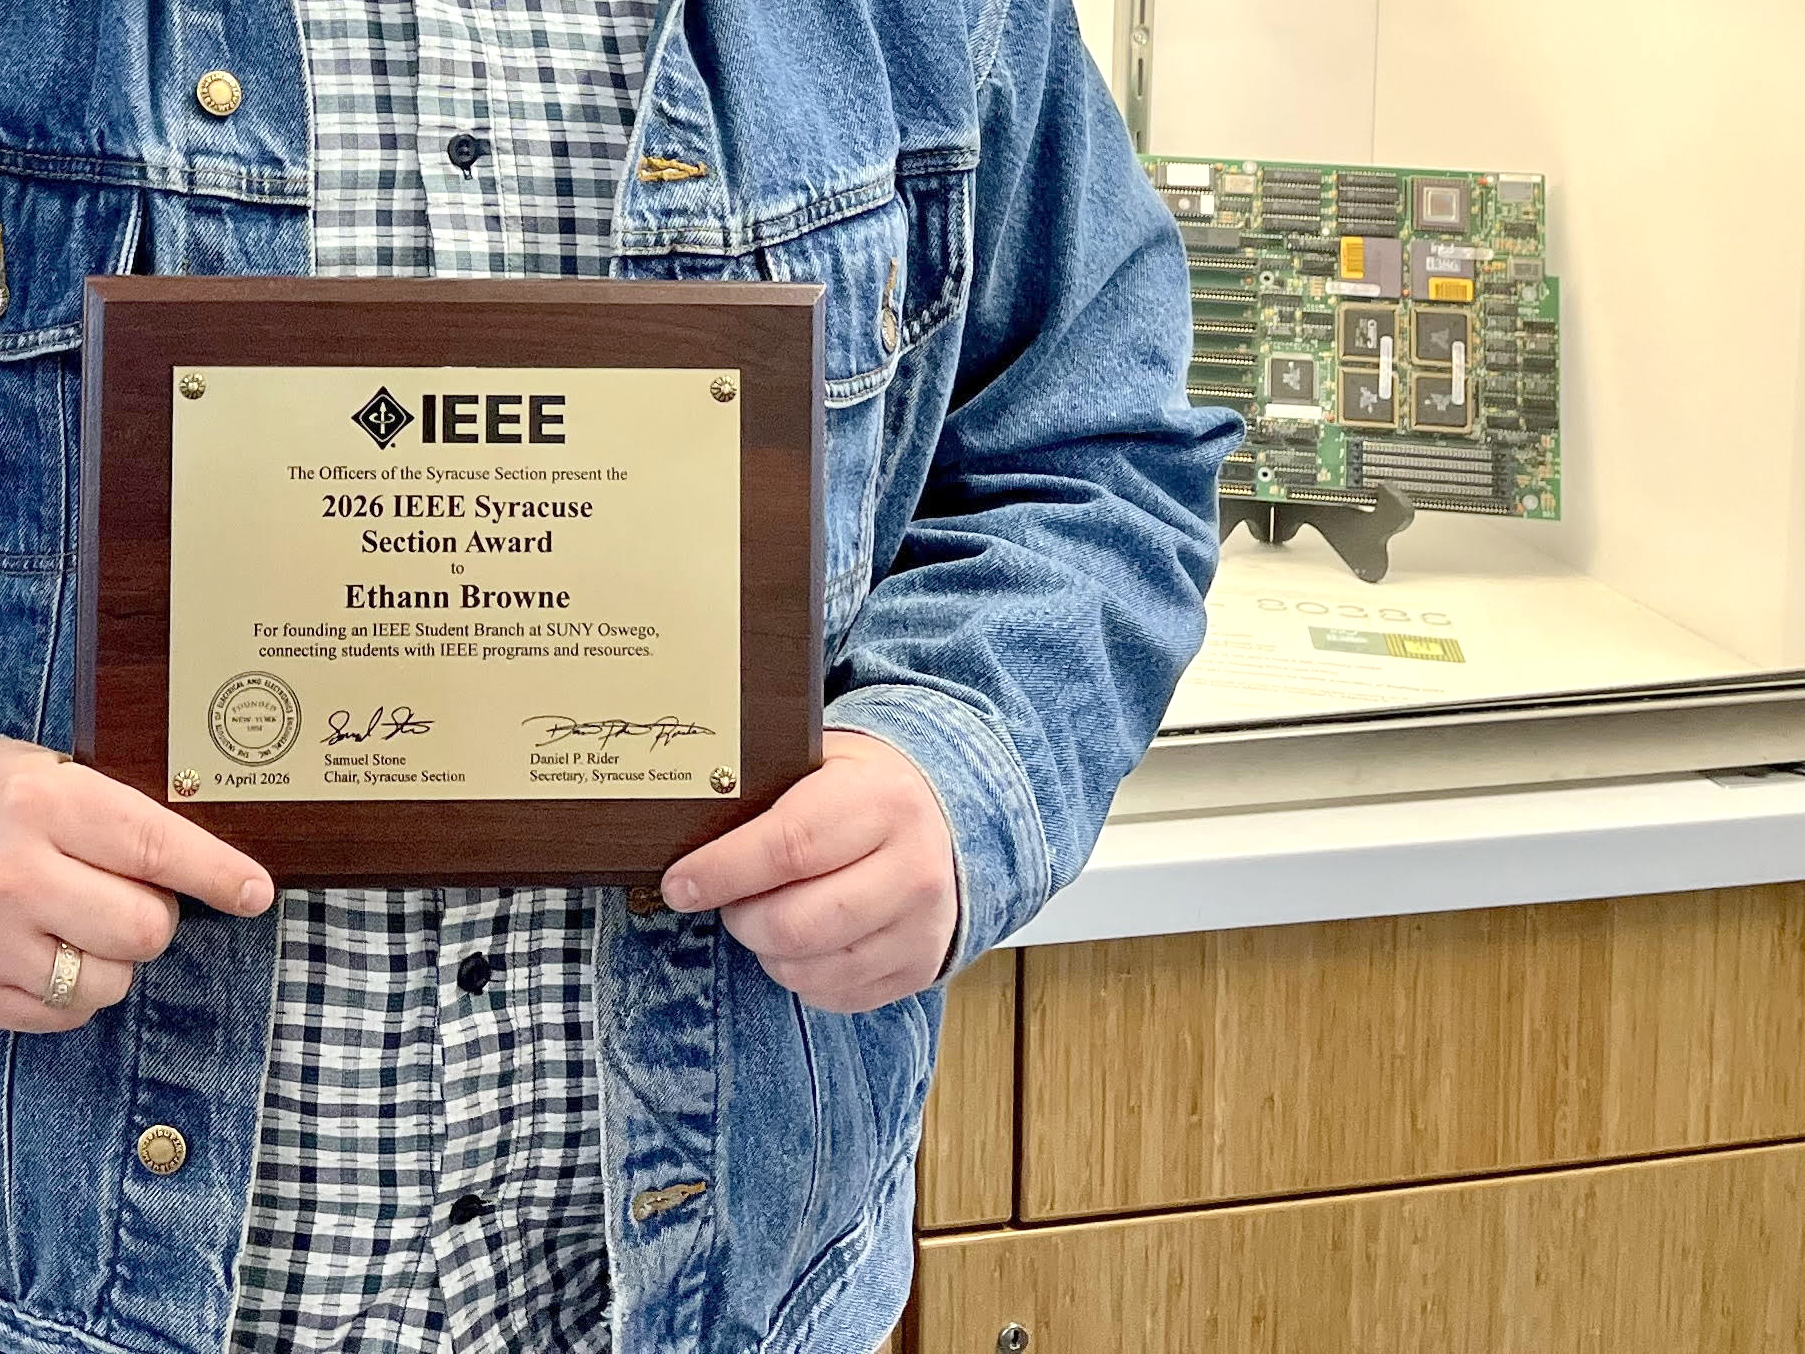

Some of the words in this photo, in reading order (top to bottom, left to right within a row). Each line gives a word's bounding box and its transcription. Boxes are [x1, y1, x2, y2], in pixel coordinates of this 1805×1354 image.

[422, 394, 566, 445] IEEE
[287, 465, 315, 481] The
[319, 465, 377, 481] Officers
[381, 465, 398, 481] of
[400, 465, 422, 481] the
[427, 465, 490, 484] Syracuse
[495, 465, 547, 481] Section
[552, 468, 603, 485] present
[607, 466, 628, 481] the
[322, 494, 384, 518] 2026
[392, 494, 466, 518] IEEE
[475, 494, 594, 524] Syracuse
[361, 529, 457, 554] Section
[464, 529, 553, 554] Award
[451, 562, 465, 575] to
[344, 583, 449, 609] Ethann
[460, 583, 571, 609] Browne
[254, 622, 279, 637] For
[283, 622, 347, 641] founding
[351, 626, 368, 638] an
[373, 622, 411, 637] IEEE
[416, 622, 470, 637] Student
[474, 622, 525, 638] Branch
[529, 624, 542, 637] at
[546, 622, 593, 637] SUNY
[598, 622, 660, 641] Oswego,
[259, 643, 338, 662] connecting
[342, 643, 400, 658] students
[404, 643, 435, 658] with
[441, 643, 478, 658] IEEE
[483, 647, 550, 662] programs
[554, 643, 579, 658] and
[584, 646, 654, 658] resources.
[324, 753, 369, 767] Samuel
[373, 753, 407, 766] Stone
[530, 752, 569, 765] Daniel
[587, 752, 620, 765] Rider
[214, 773, 223, 786] 9
[225, 772, 257, 789] April
[260, 772, 291, 785] 2026
[324, 770, 360, 785] Chair,
[364, 770, 418, 786] Syracuse
[421, 769, 466, 783] Section
[529, 769, 588, 785] Secretary,
[592, 768, 645, 785] Syracuse
[648, 768, 693, 782] Section
